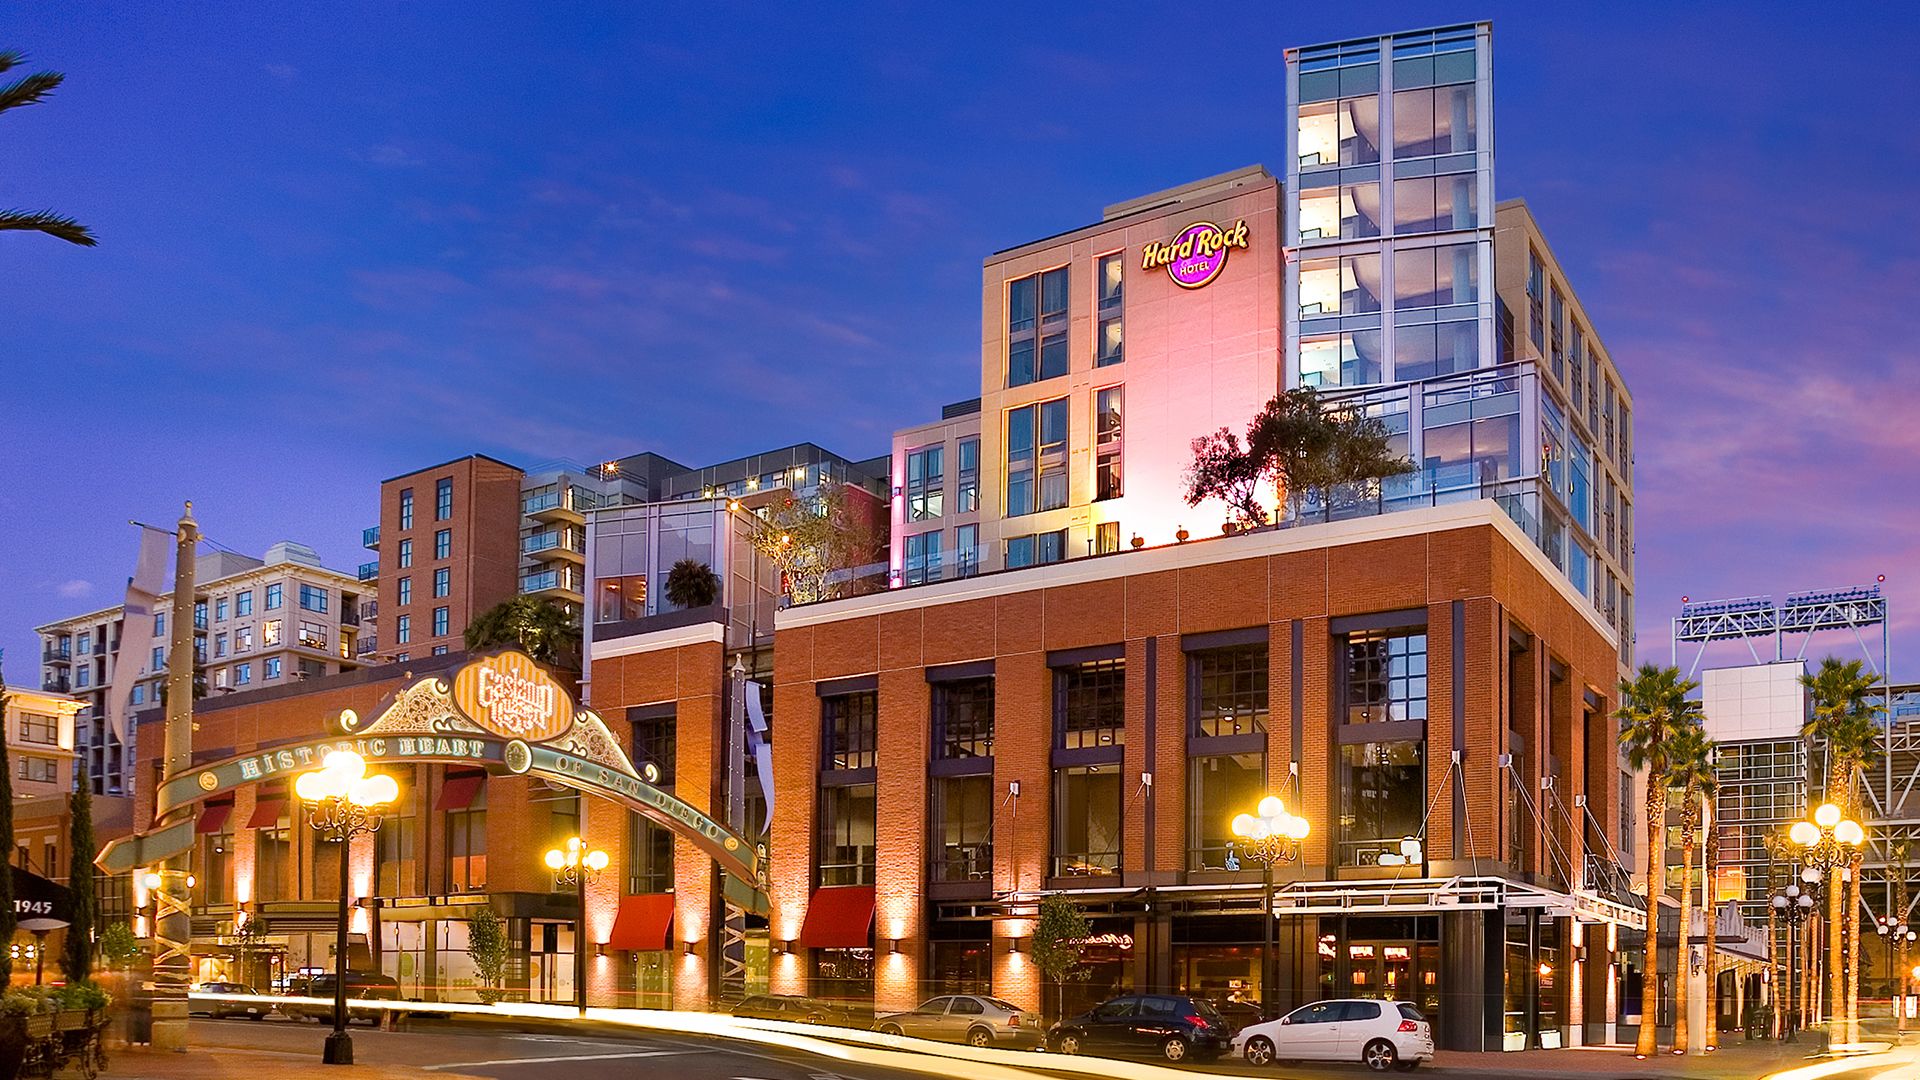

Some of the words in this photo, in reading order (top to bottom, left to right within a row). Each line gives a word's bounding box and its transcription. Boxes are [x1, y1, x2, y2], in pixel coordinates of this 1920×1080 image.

[1141, 233, 1196, 270] Hard
[1197, 218, 1249, 258] Rock
[1179, 261, 1210, 276] HOTEL
[479, 666, 553, 718] Gaslamp
[399, 737, 486, 758] HEART
[555, 756, 583, 774] OF
[598, 769, 641, 797] SAN
[655, 793, 719, 839] DIEGO
[12, 899, 53, 914] 1945
